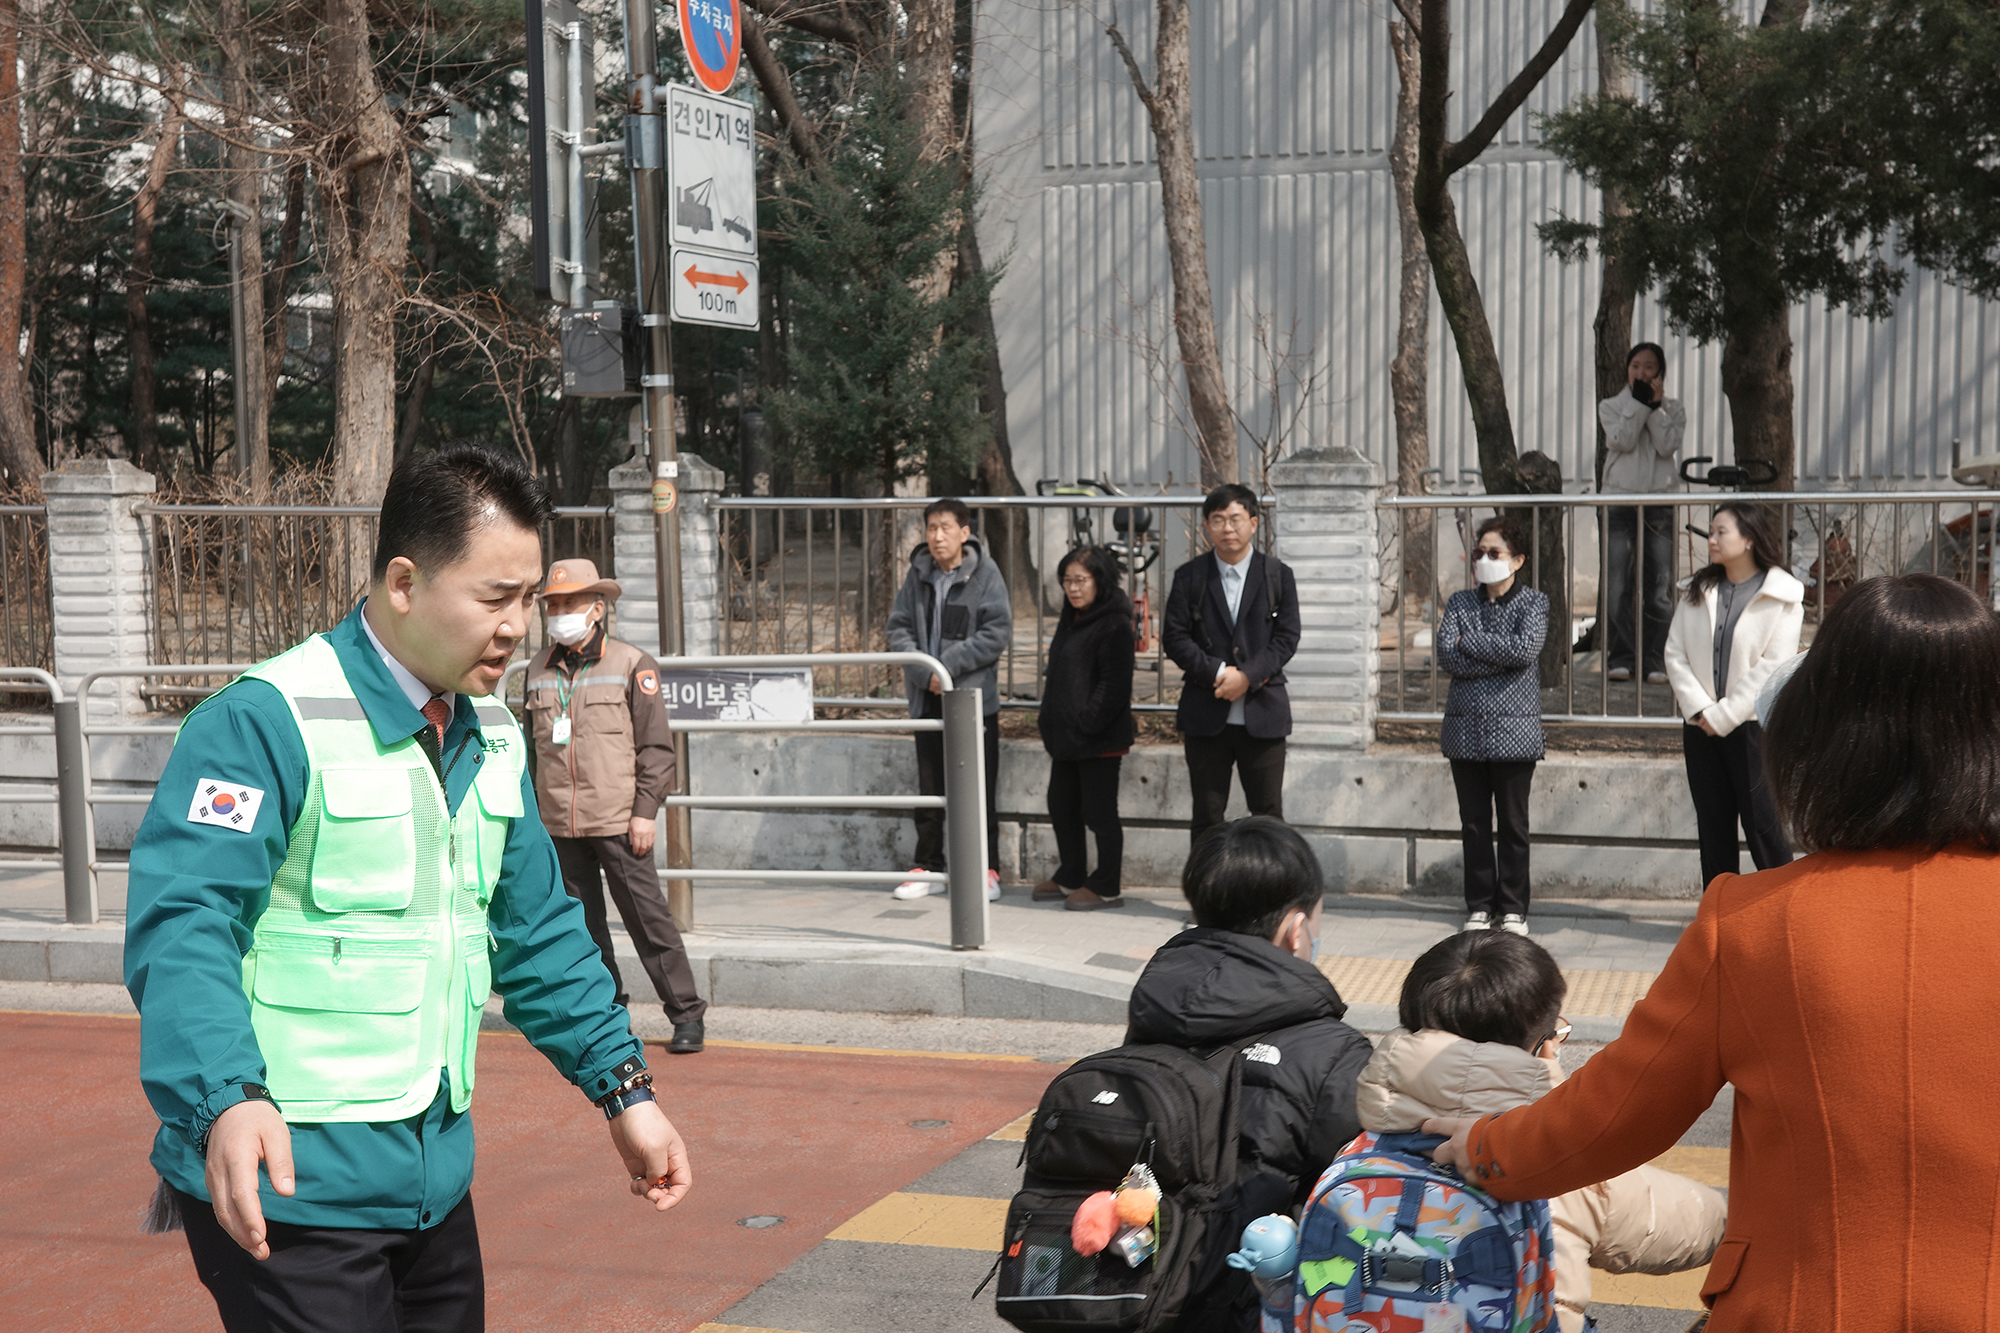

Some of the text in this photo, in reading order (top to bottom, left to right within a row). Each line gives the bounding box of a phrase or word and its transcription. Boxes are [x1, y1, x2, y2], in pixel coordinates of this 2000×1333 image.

[689, 0, 733, 36] 주차금지
[674, 101, 750, 150] 견인지역
[698, 291, 737, 314] 100m
